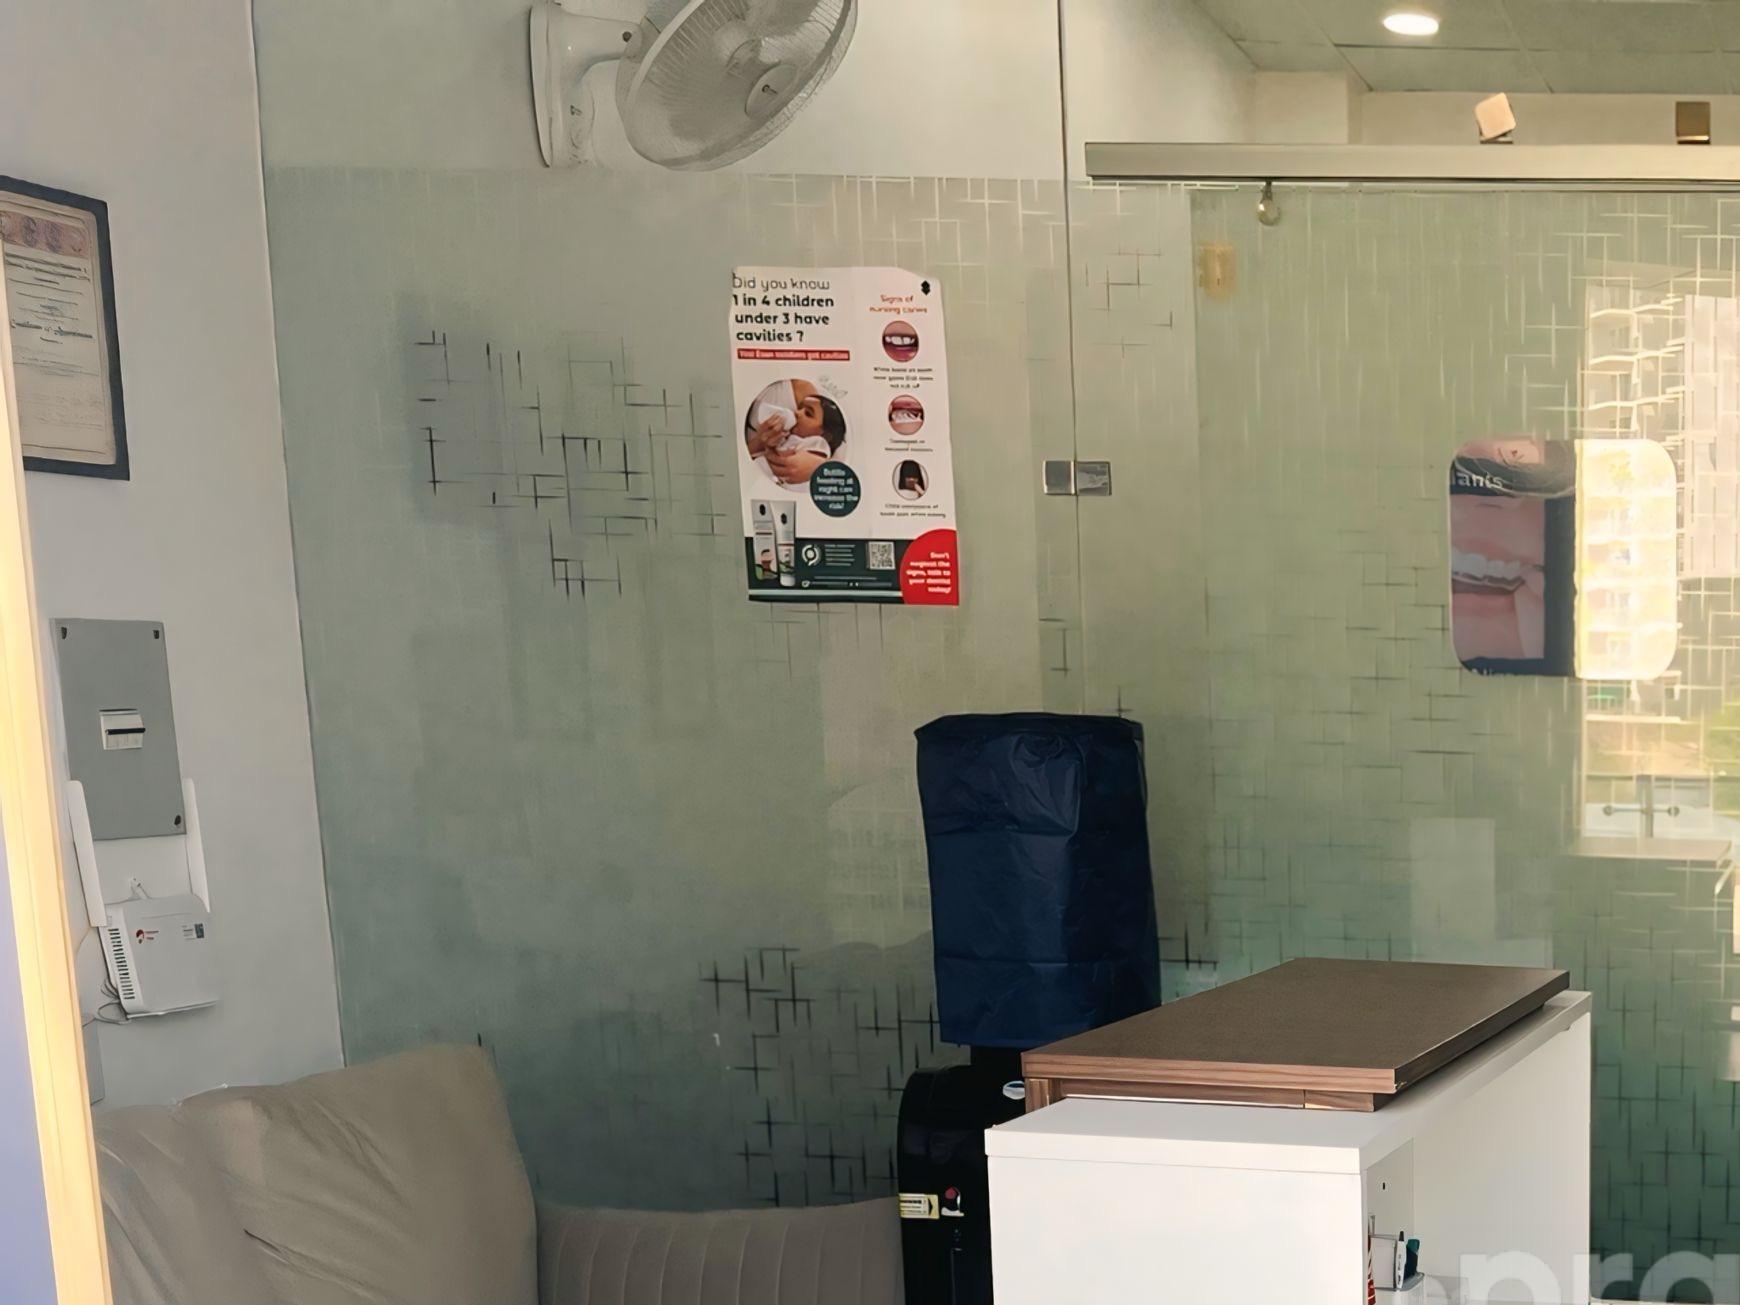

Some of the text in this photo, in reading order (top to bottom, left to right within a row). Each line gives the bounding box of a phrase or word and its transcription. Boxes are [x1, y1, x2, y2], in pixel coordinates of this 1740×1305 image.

[732, 272, 830, 292] Did you know
[733, 293, 834, 307] 1 in 4 children
[735, 312, 830, 325] under 3 have
[736, 329, 804, 342] cavities ?
